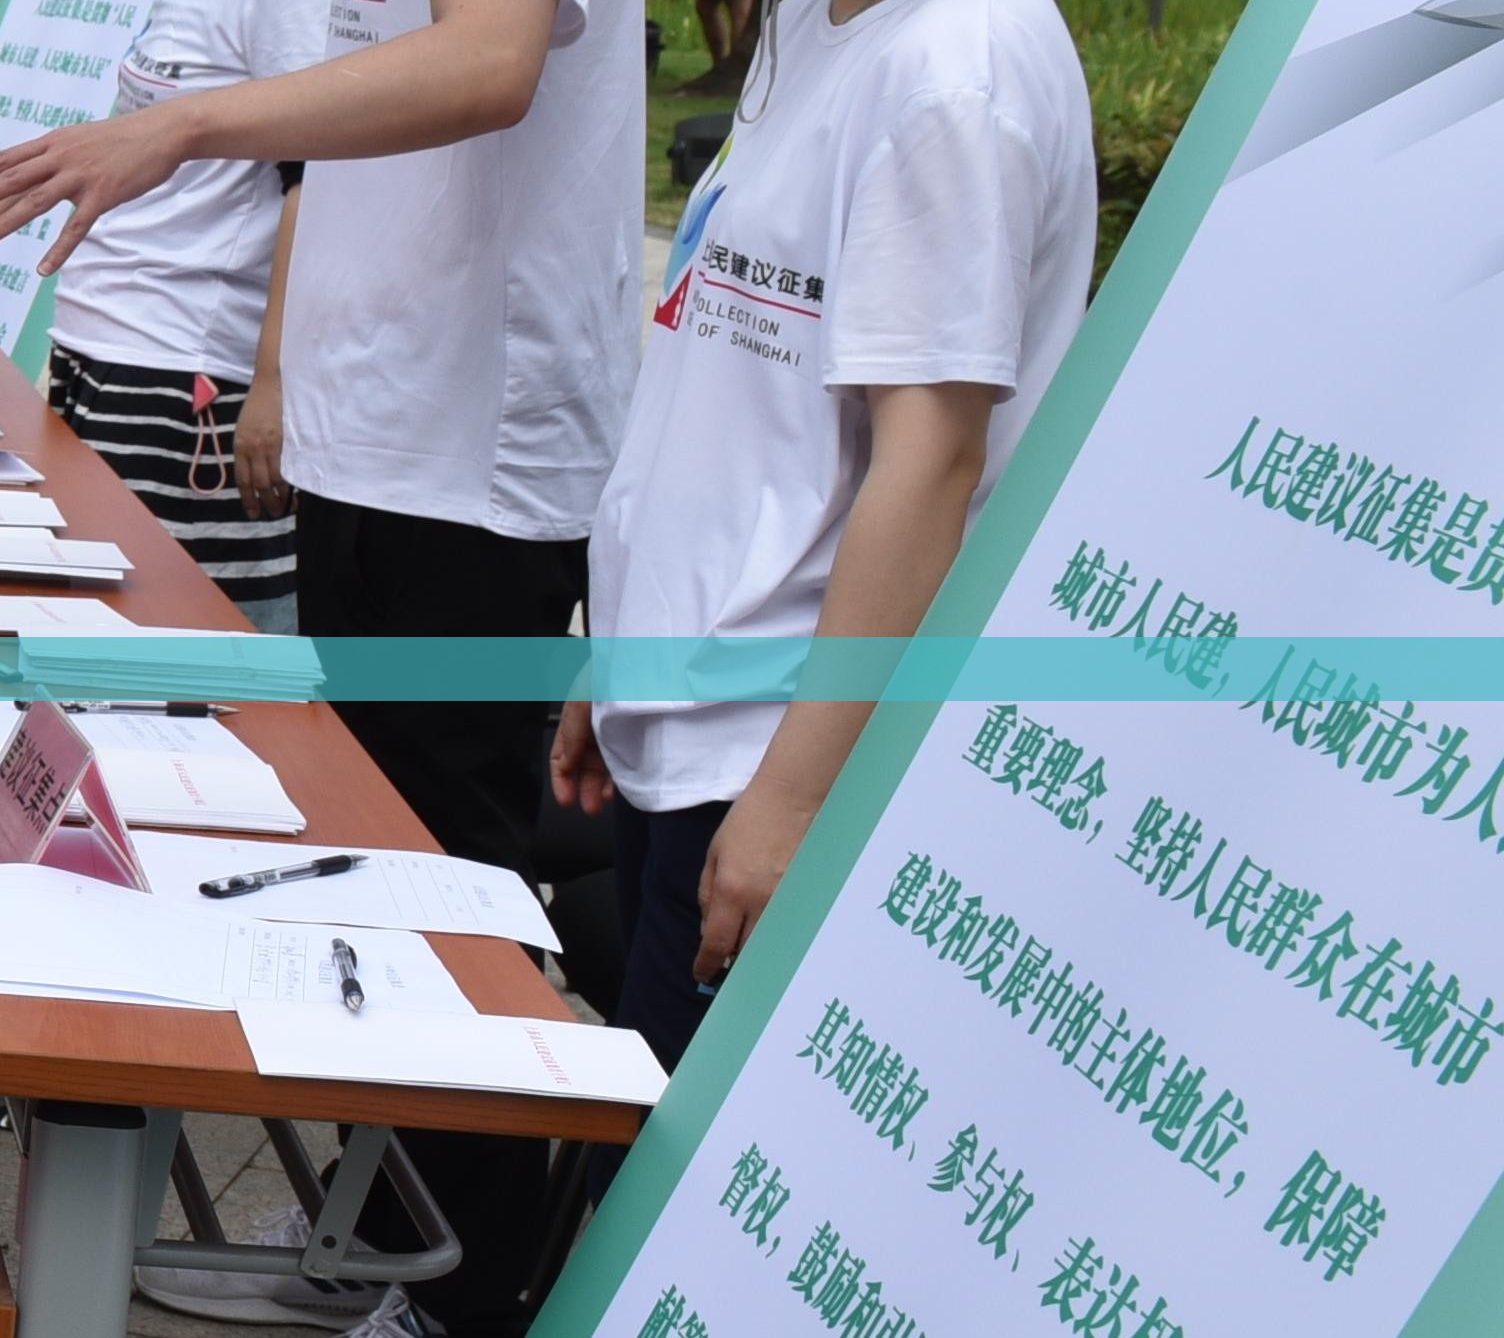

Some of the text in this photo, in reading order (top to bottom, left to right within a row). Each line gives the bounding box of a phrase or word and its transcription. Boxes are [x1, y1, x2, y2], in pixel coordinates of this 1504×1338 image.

[697, 322, 801, 368] OF SHANGHAI
[1048, 540, 1504, 854] 城市人民建，人民城市为人
[878, 852, 1386, 1283] 建设和发展中的主体地位，保障
[961, 703, 1504, 1086] 重要理念，坚持人民群众在城市
